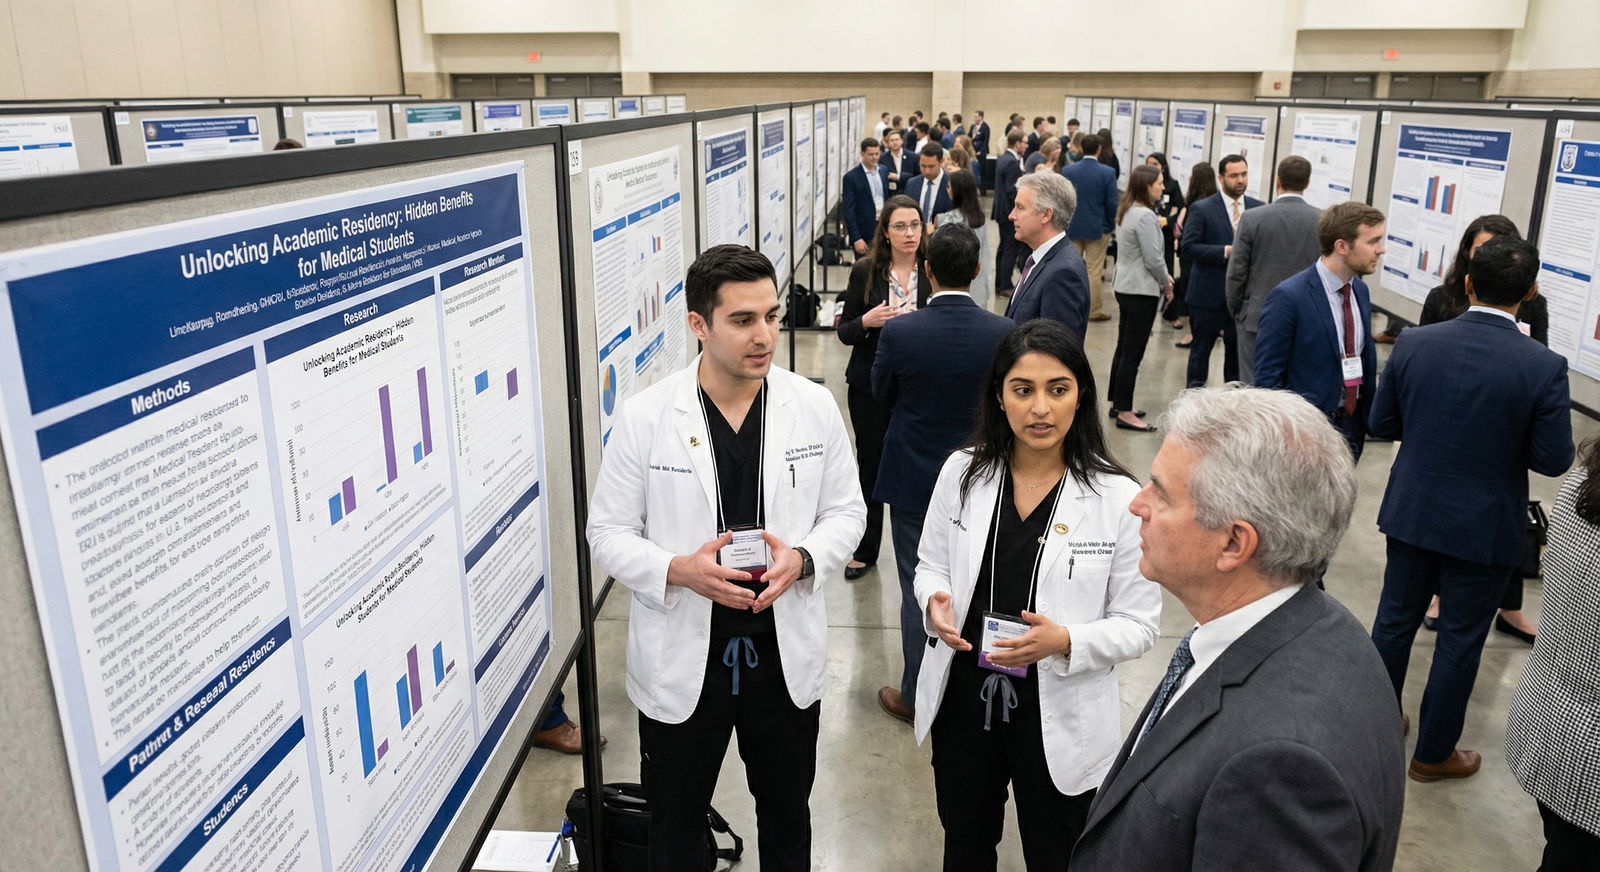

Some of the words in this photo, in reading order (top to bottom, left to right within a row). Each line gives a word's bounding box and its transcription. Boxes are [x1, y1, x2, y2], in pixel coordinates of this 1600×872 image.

[181, 240, 269, 278] Unlocking
[273, 222, 338, 257] Academic
[342, 211, 403, 237] Residency:
[404, 200, 438, 219] Hidden
[439, 191, 474, 212] Benefits
[298, 256, 320, 278] for
[321, 240, 367, 272] Medical
[370, 230, 415, 256] Students
[464, 260, 487, 277] Research
[344, 303, 378, 326] Research
[303, 351, 335, 372] Unlocking
[336, 339, 364, 357] Academic
[365, 328, 394, 344] Residency:
[396, 316, 414, 328] Hidden
[323, 360, 348, 378] Benefits
[349, 354, 358, 365] for
[359, 346, 380, 360] Medical
[381, 334, 404, 350] Students
[131, 379, 190, 415] Methods
[65, 467, 85, 486] The
[166, 416, 197, 438] medical
[152, 453, 184, 479] Medical
[335, 601, 362, 628] Unlocking
[362, 580, 385, 605] Academic
[358, 600, 379, 623] Students
[386, 578, 404, 597] Medical
[404, 557, 424, 578] Students
[96, 629, 114, 650] The
[215, 638, 229, 658] help
[173, 716, 184, 732] &
